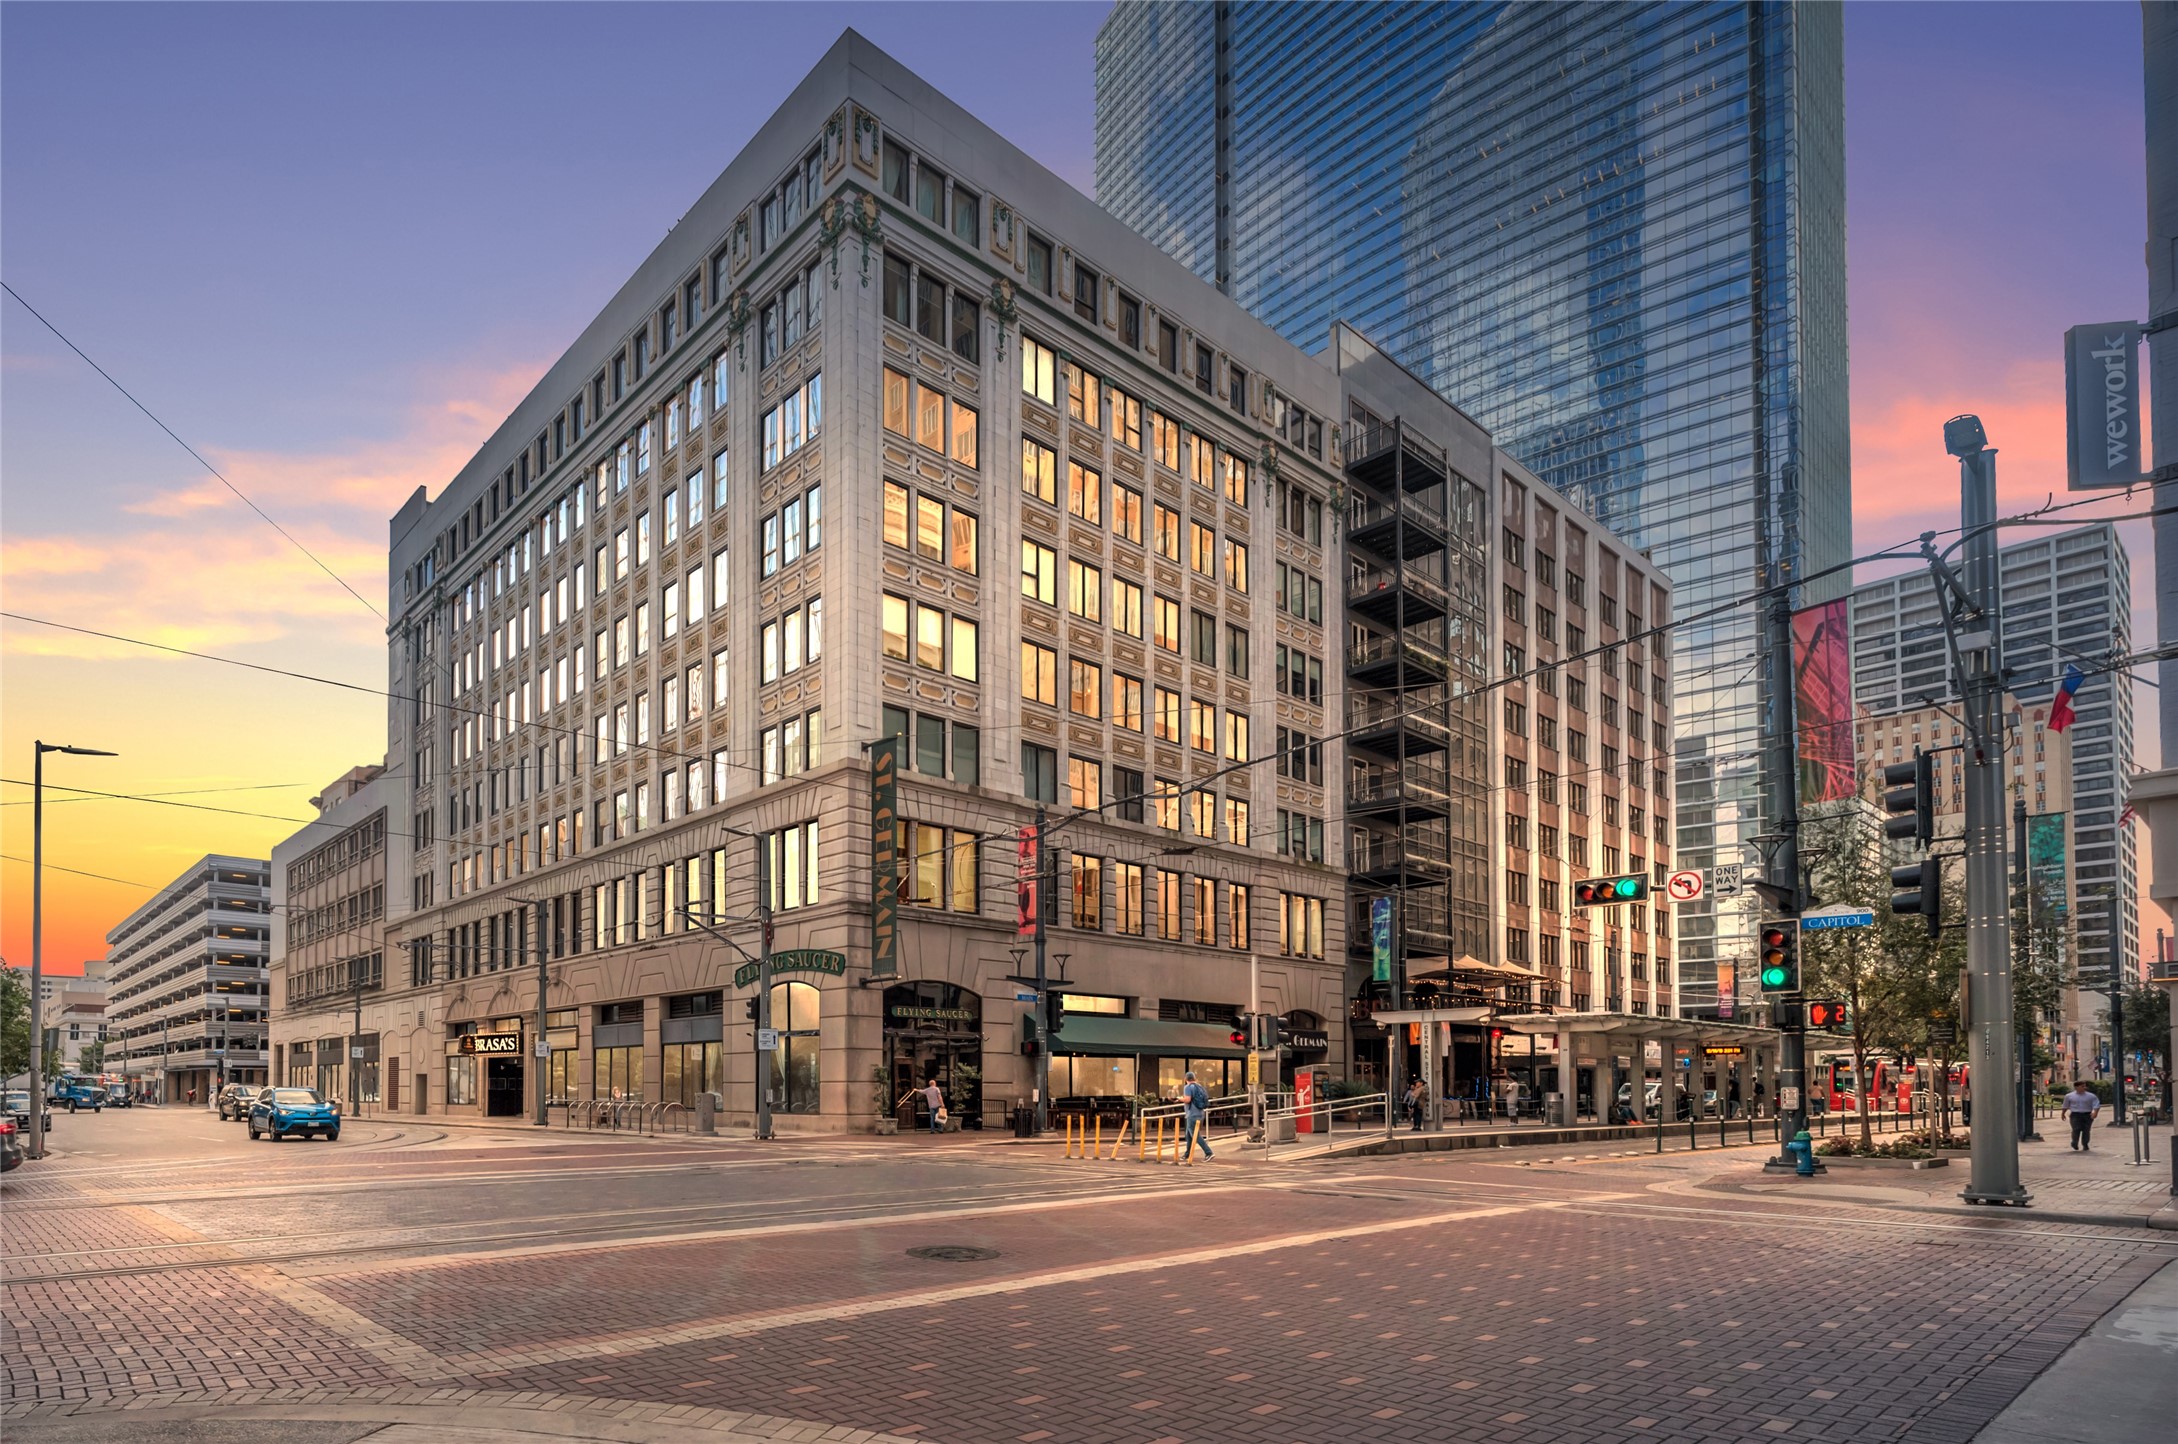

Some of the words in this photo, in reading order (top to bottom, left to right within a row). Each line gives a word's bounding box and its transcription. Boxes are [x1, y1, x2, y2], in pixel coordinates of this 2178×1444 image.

[2091, 332, 2128, 470] wework
[876, 752, 892, 800] ST.
[1716, 866, 1738, 876] ONE
[876, 808, 892, 959] GERMAIN
[1715, 875, 1739, 885] WAY
[1808, 916, 1865, 928] CAPITOL
[787, 952, 840, 972] SAUCER
[897, 1007, 932, 1017] FLYING
[935, 1009, 970, 1019] SAUCER
[1835, 1005, 1844, 1021] 2
[475, 1037, 515, 1051] BRASA'S
[1293, 1035, 1328, 1047] GERMAIN
